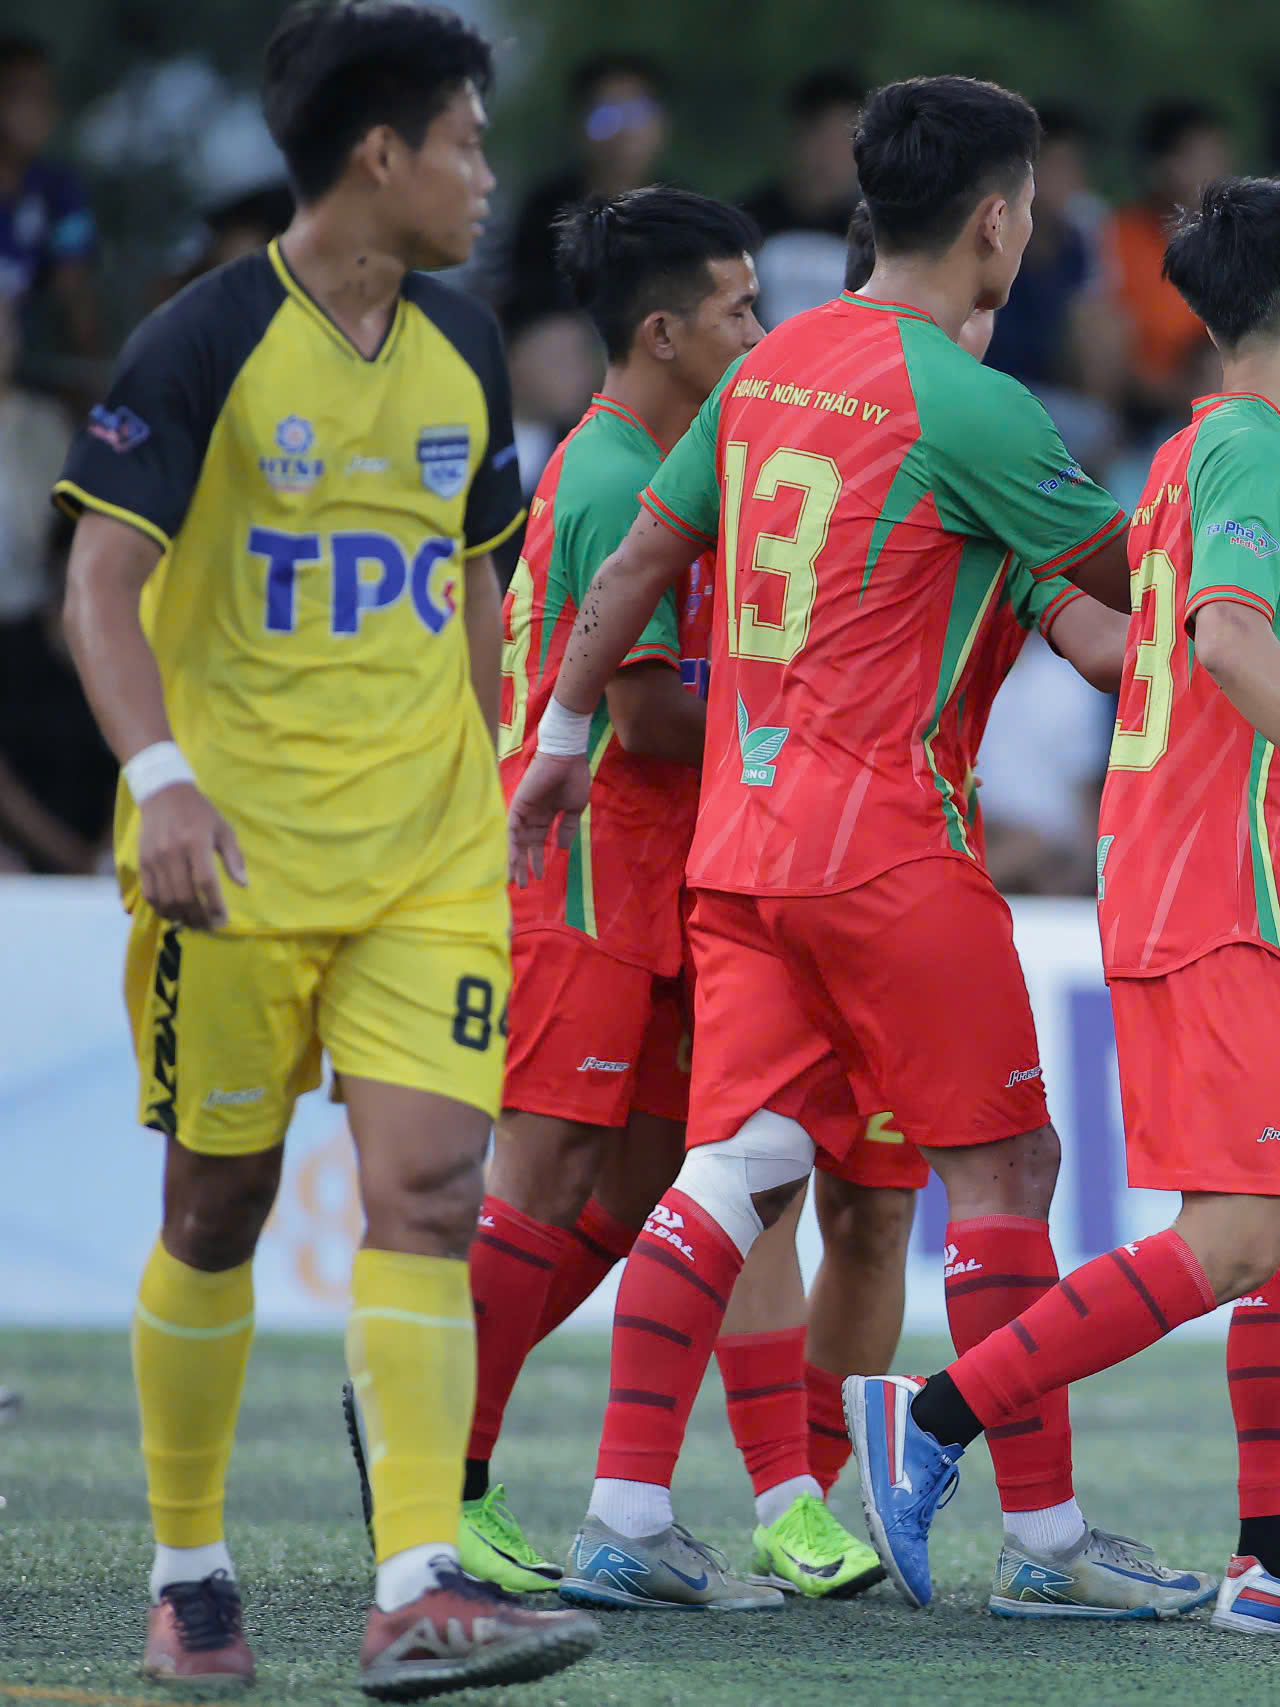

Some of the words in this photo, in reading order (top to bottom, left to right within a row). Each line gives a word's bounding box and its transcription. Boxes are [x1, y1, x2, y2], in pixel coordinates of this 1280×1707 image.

[770, 382, 814, 407] NÔNG
[861, 402, 891, 425] VY
[1036, 477, 1059, 495] Ta
[1205, 522, 1221, 537] Ta
[1224, 520, 1255, 541] Pha
[1229, 536, 1259, 552] Media
[724, 441, 843, 666] 13
[452, 972, 508, 1053] 8
